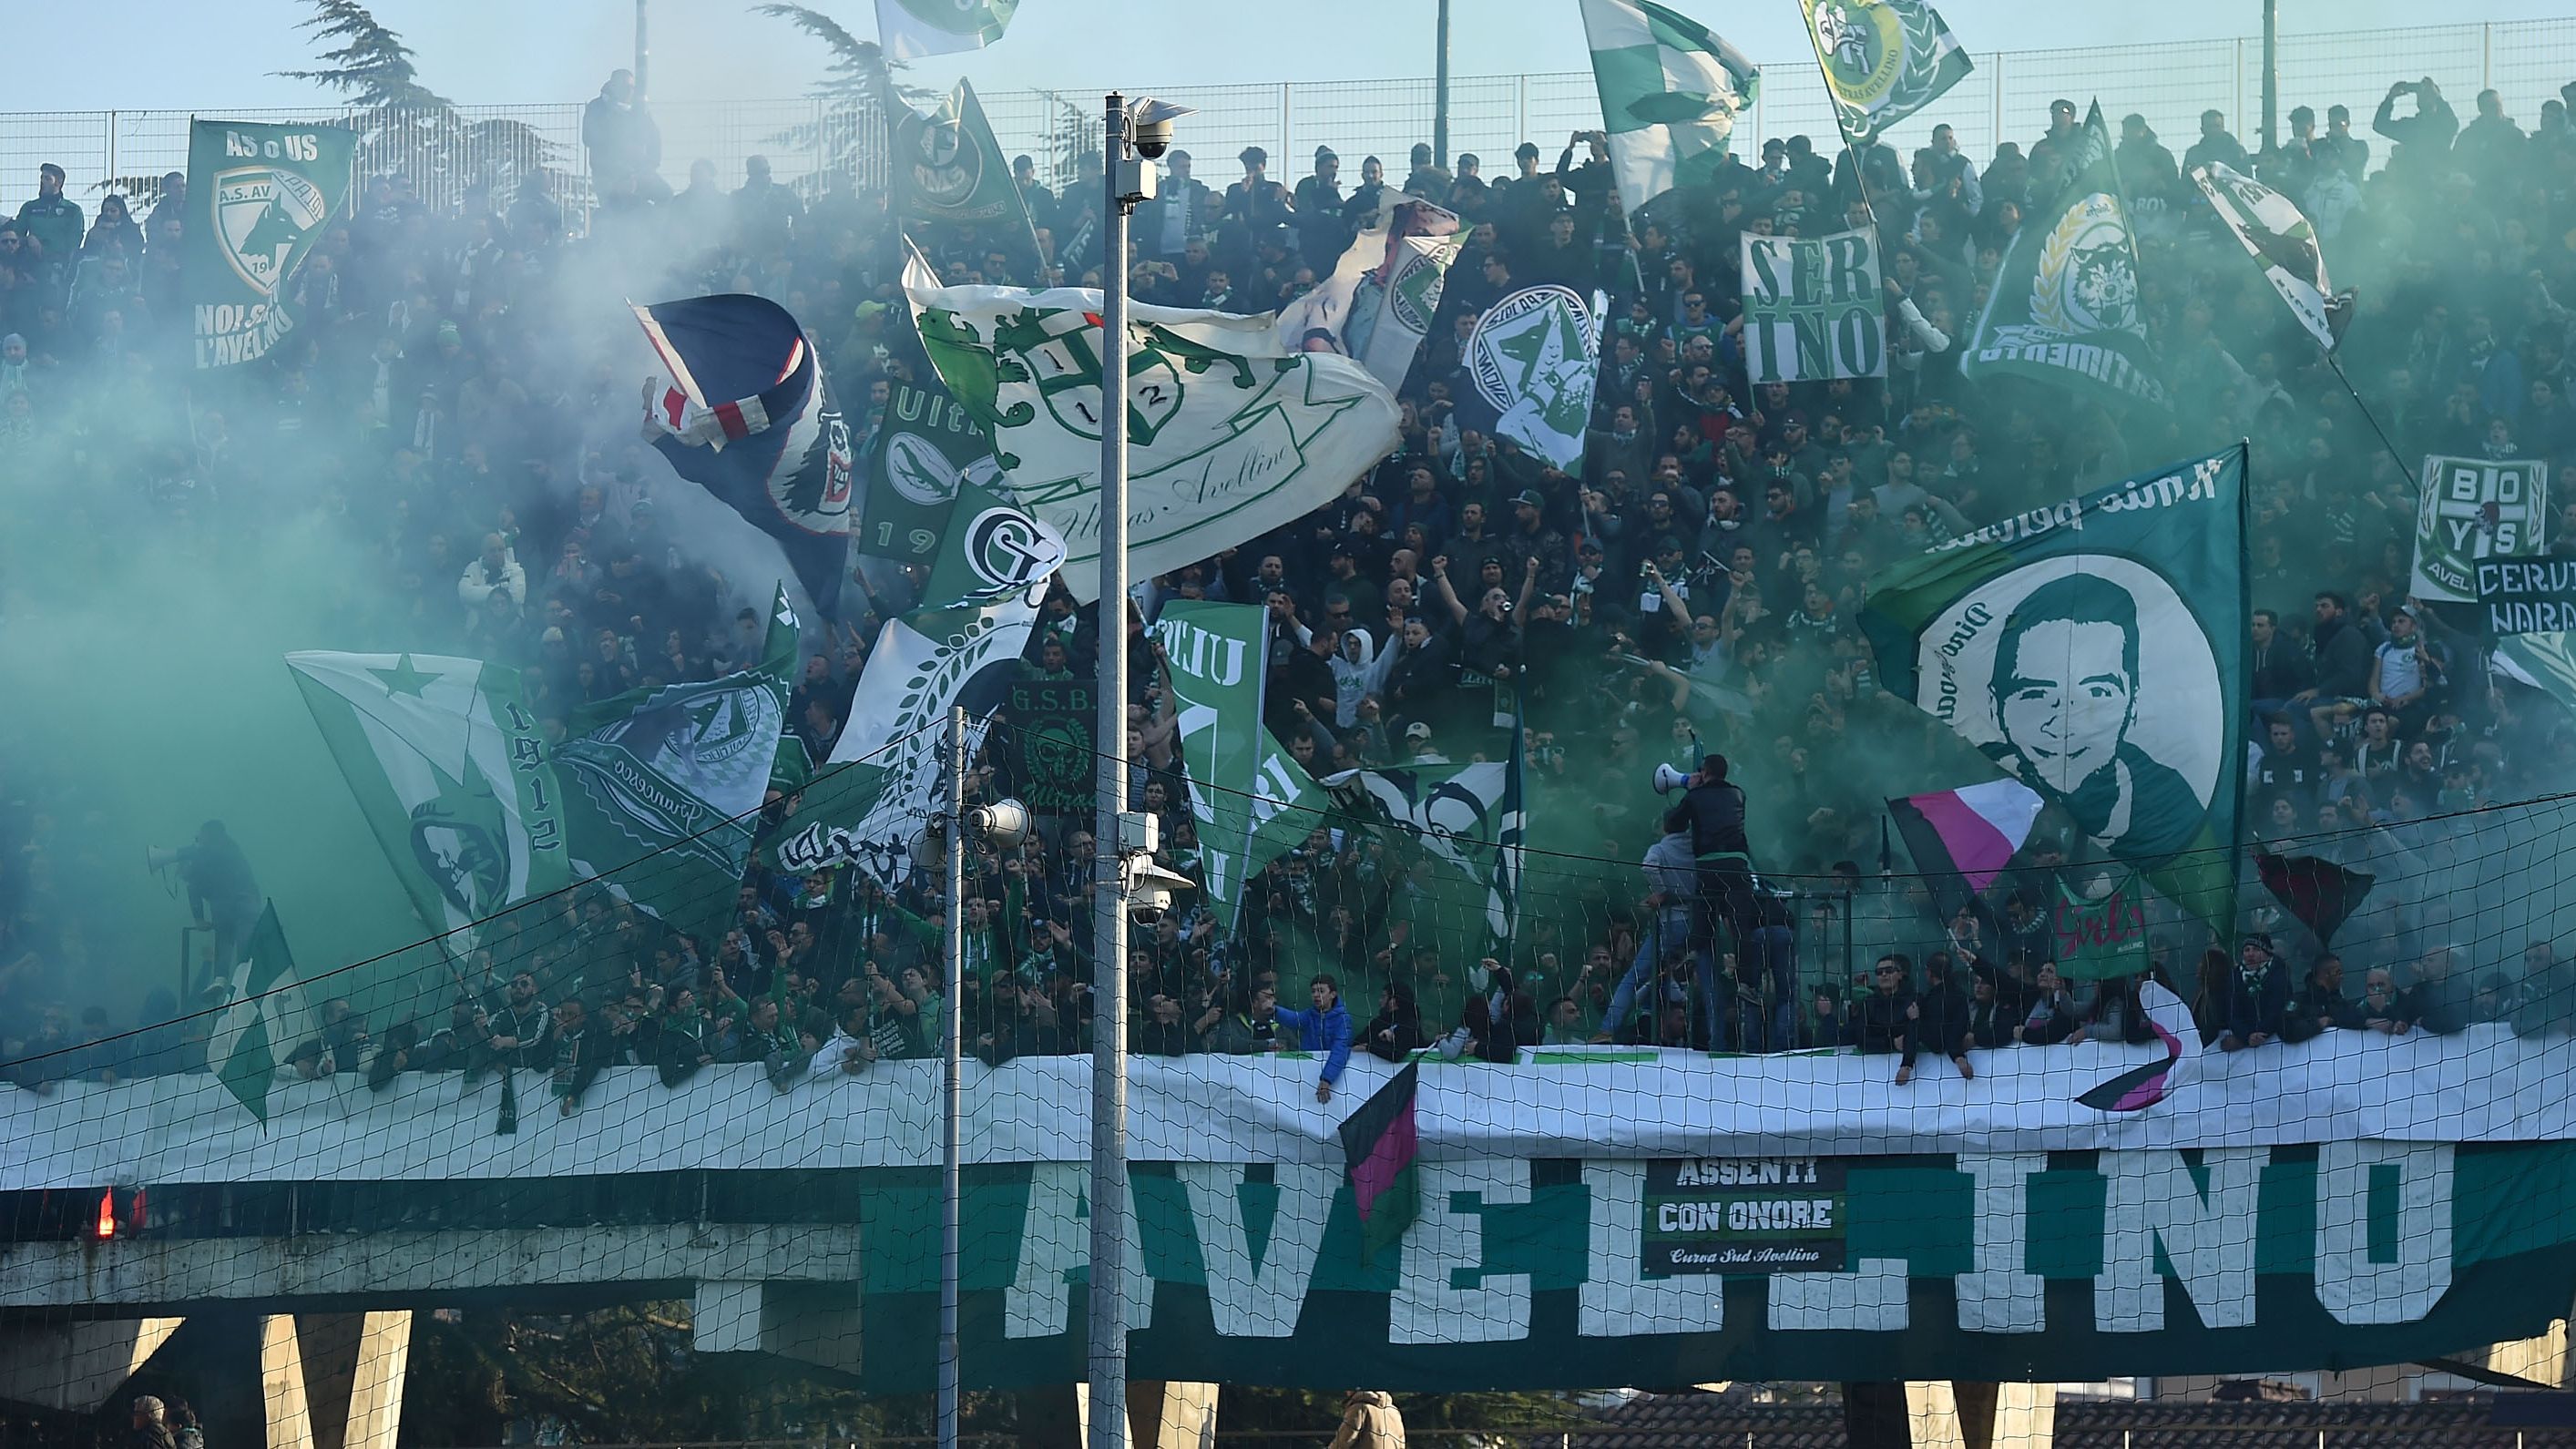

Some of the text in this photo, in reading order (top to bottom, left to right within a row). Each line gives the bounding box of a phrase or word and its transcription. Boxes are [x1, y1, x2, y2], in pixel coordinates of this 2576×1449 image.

[1866, 48, 1900, 98] AVELLINO
[226, 130, 258, 158] AS
[284, 134, 318, 161] US
[1751, 235, 1875, 307] SER
[194, 303, 244, 336] NOI
[1754, 306, 1880, 382] INO
[2056, 893, 2144, 959] Girls
[1676, 1158, 1818, 1186] ASSENTI
[1659, 1199, 1833, 1232] CON ONORE
[1005, 1140, 2456, 1345] AVELLINO
[1670, 1247, 1821, 1264] Curva Sud Avellino
